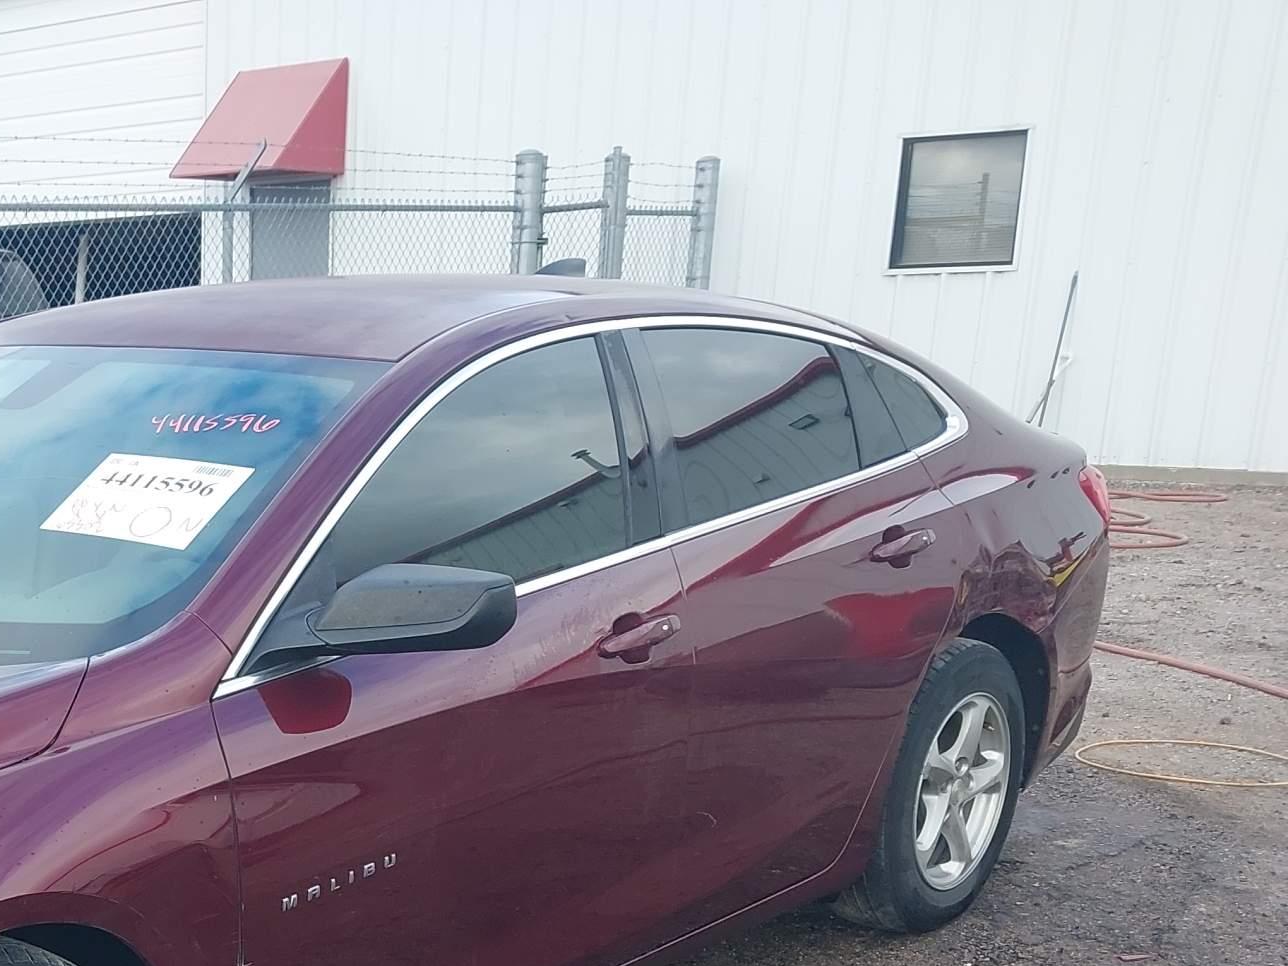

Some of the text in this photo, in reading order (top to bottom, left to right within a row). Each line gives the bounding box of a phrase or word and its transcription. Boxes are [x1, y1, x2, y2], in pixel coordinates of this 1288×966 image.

[151, 412, 281, 433] 44115596
[101, 471, 217, 497] 44115596
[280, 852, 398, 913] MALIBU
